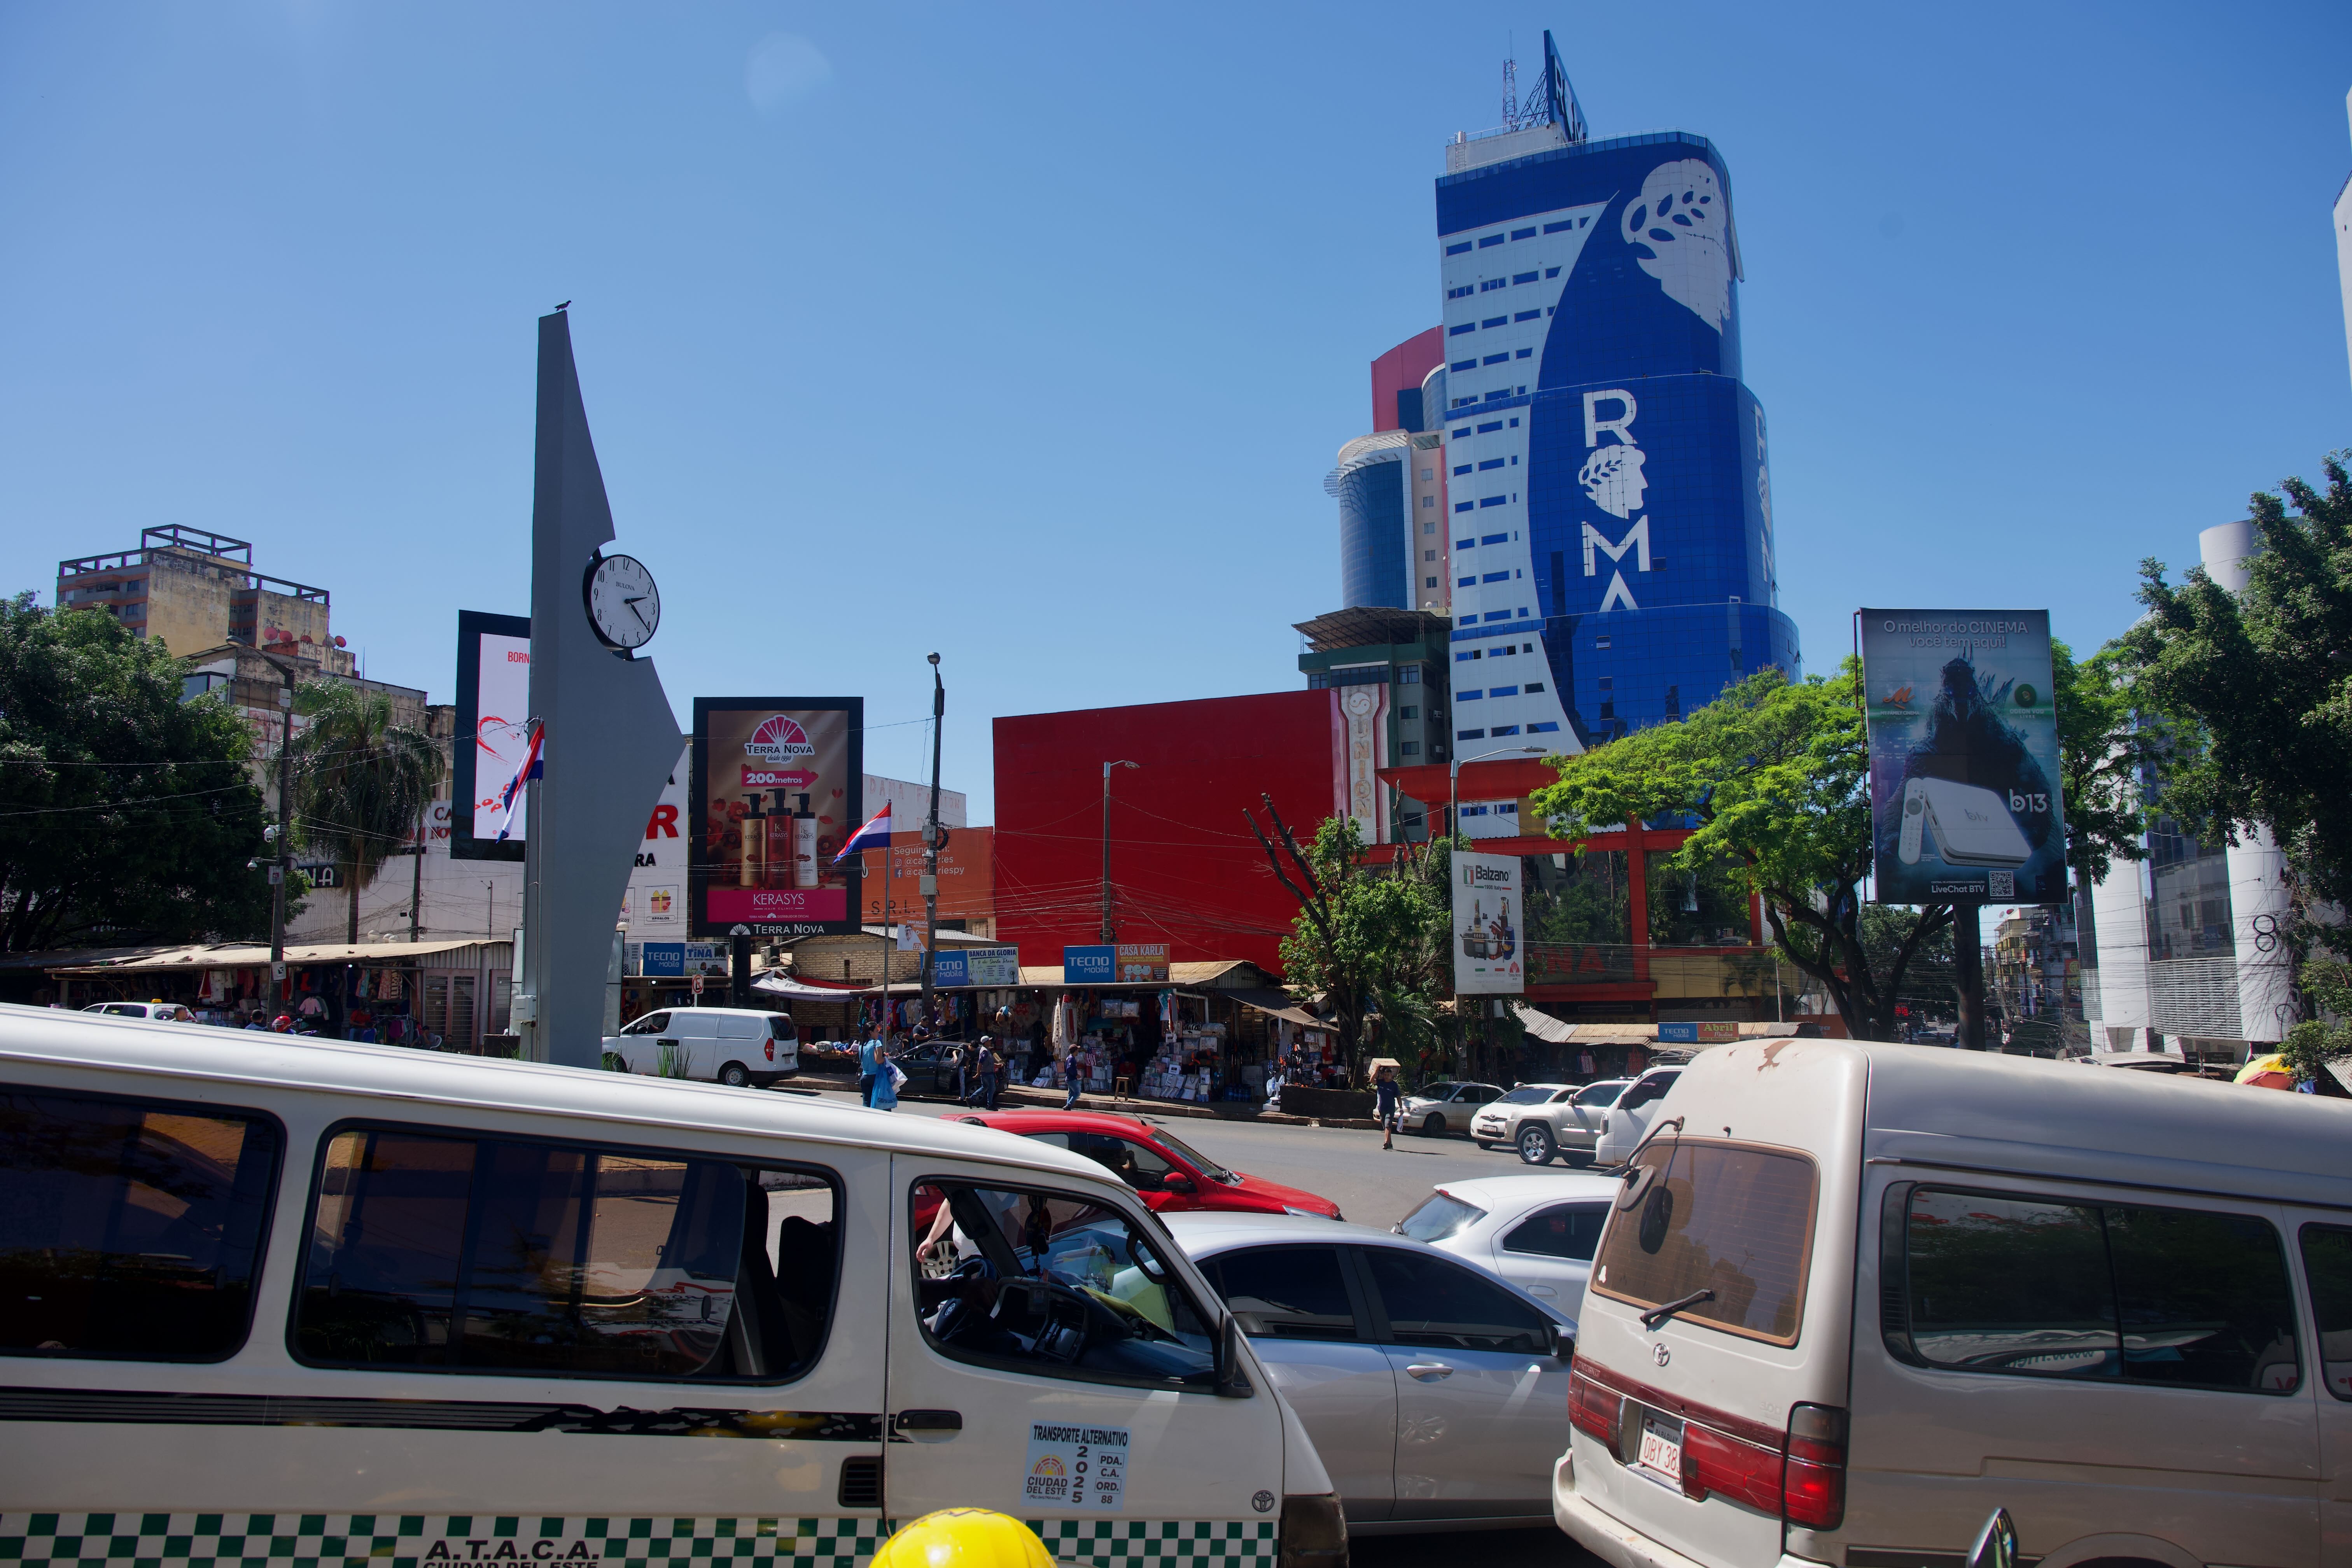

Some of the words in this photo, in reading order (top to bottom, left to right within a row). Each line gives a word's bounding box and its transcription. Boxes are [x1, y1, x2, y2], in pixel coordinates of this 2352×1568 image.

[610, 559, 614, 571] 11
[623, 558, 630, 570] 12
[598, 569, 604, 583] 10
[639, 568, 641, 579] 1
[616, 582, 635, 592] BULOVA
[648, 582, 651, 594] 2
[594, 588, 598, 600] 9
[598, 609, 602, 621] 8
[651, 603, 655, 615] 3
[608, 625, 612, 637] 7
[646, 621, 650, 633] 4
[1883, 620, 1895, 632] O
[1898, 620, 1946, 633] melhor
[1949, 621, 1966, 633] do
[1969, 621, 2028, 634] CINEMA
[622, 634, 626, 646] 6
[637, 632, 640, 644] 5
[1908, 634, 1941, 647] você
[1942, 637, 1971, 647] tem
[1973, 635, 2006, 650] aqui!
[508, 651, 529, 663] BORN
[746, 745, 780, 753] TERRA
[784, 745, 812, 753] NOVA
[1354, 719, 1371, 818] UNION
[870, 778, 904, 800] DAMA
[917, 787, 959, 809] FAHION
[2009, 789, 2047, 812] b13
[894, 847, 929, 855] Seguino
[754, 893, 805, 905] KERASYS
[754, 924, 791, 934] TERRA
[794, 924, 824, 934] NOVA
[647, 952, 679, 961] TECNO
[1120, 946, 1138, 956] CASA
[1141, 945, 1164, 956] KARLA
[934, 961, 962, 971] ECNO
[1069, 957, 1109, 966] TECNO
[1034, 1425, 1080, 1443] TRANSPORTE
[1081, 1429, 1128, 1447] ALTERNATIVO
[1656, 1429, 1678, 1444] PARAGUAY
[1644, 1436, 1663, 1464] OBY
[1100, 1455, 1122, 1465] PDA.
[1101, 1468, 1119, 1477] C.A.
[1027, 1476, 1068, 1487] CIUDAD
[1096, 1481, 1119, 1491] ORD.
[1027, 1486, 1043, 1494] DEL
[1045, 1487, 1067, 1495] ESTE
[1101, 1495, 1113, 1504] 88
[425, 1540, 599, 1560] A.T.A.C.A.
